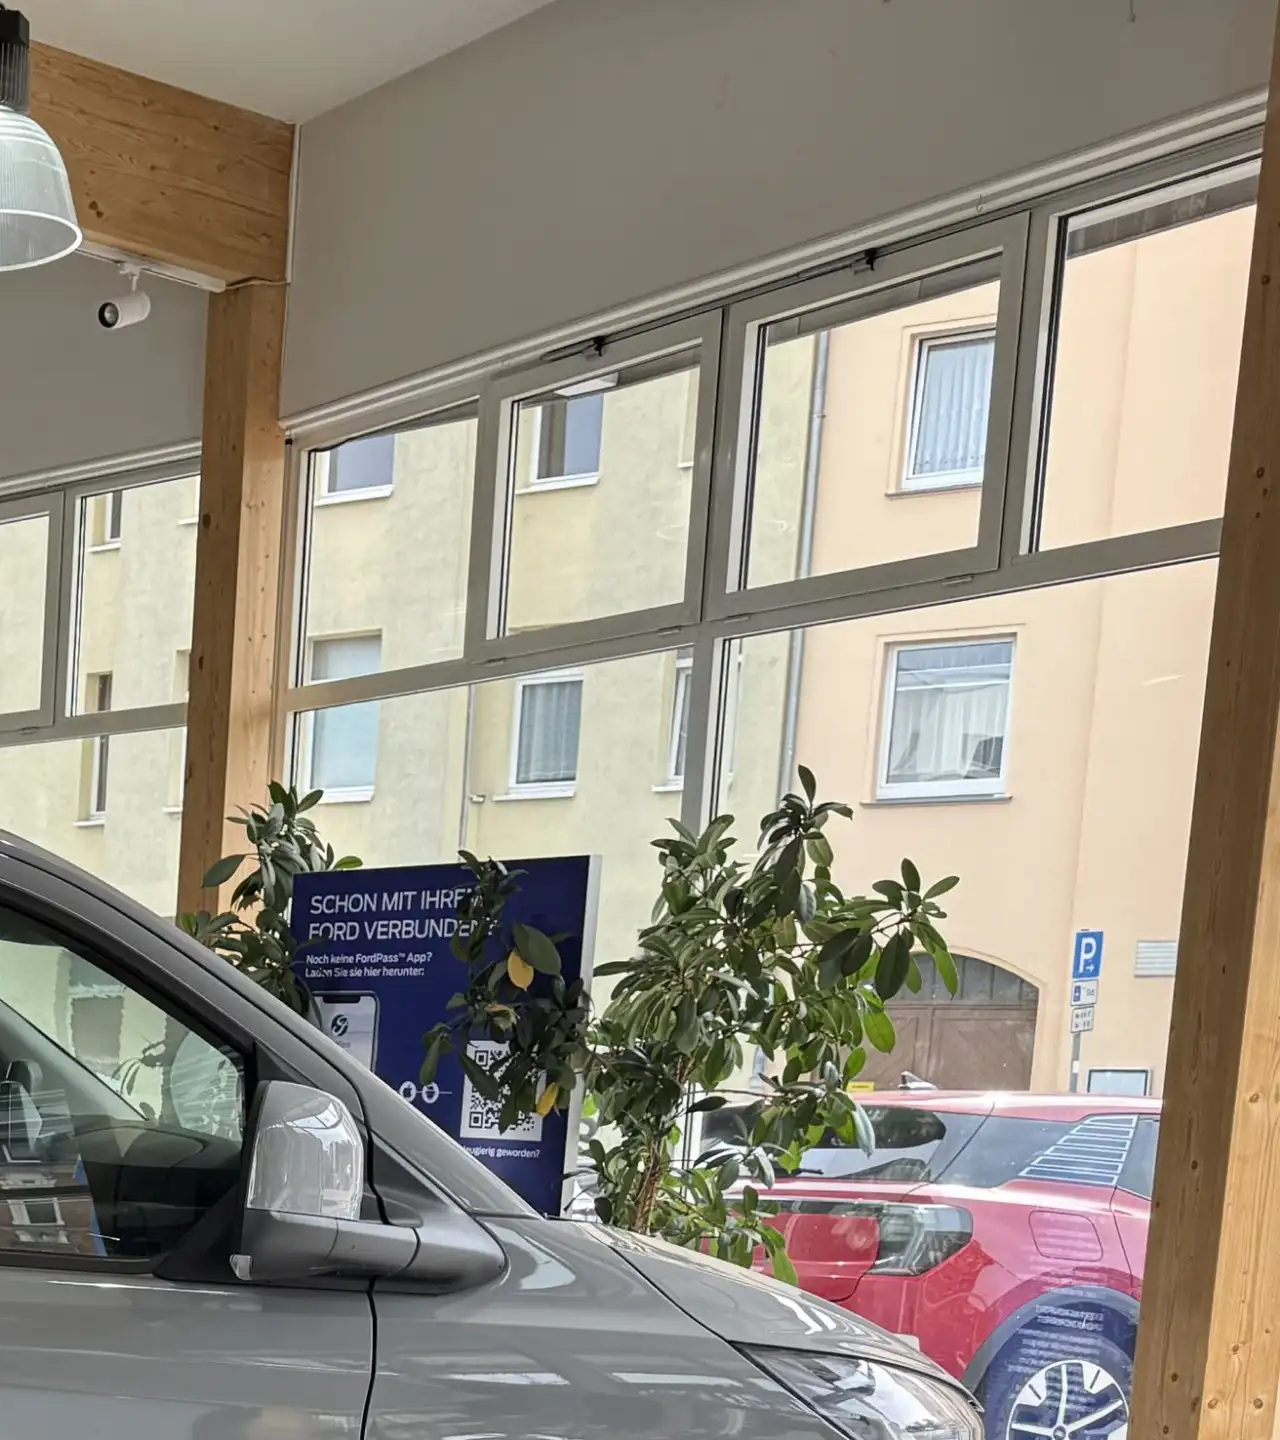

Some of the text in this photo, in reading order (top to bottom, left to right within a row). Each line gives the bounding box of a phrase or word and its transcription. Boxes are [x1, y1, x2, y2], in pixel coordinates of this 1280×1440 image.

[310, 893, 377, 914] SCHON
[382, 891, 417, 911] MIT
[308, 922, 359, 941] FORD
[306, 954, 329, 965] Noch
[330, 953, 355, 964] keine
[406, 952, 433, 964] App?
[1079, 937, 1096, 974] P
[334, 966, 349, 977] Sie
[349, 967, 363, 977] sie
[364, 966, 381, 977] hier
[382, 965, 425, 977] herunter:
[496, 1147, 540, 1158] geworden?
